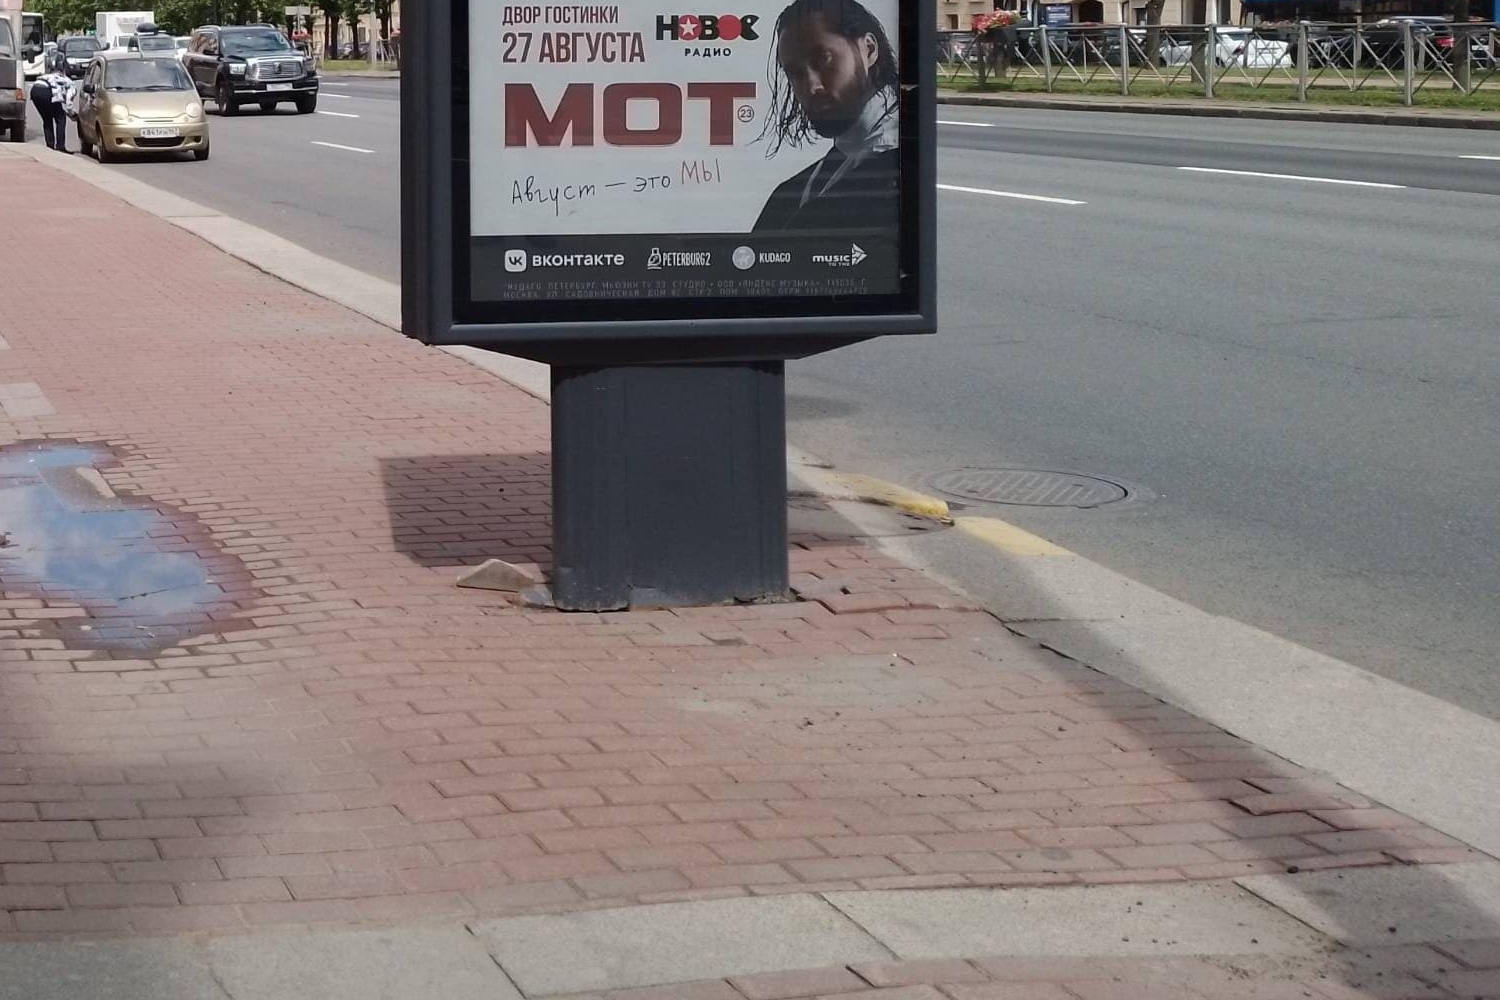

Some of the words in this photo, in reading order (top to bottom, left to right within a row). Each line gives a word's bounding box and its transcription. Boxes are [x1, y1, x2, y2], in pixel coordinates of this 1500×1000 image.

[502, 6, 543, 27] ДВОР
[544, 6, 619, 25] ГОСТИНКИ
[502, 33, 536, 64] 27
[538, 32, 645, 63] АВГУСТА
[684, 48, 732, 58] РАДИО
[504, 82, 757, 148] МОТ
[511, 175, 596, 217] Август
[632, 175, 671, 193] это
[662, 252, 711, 267] PETERBURG2
[759, 252, 791, 264] KUDAGO
[812, 255, 851, 263] music
